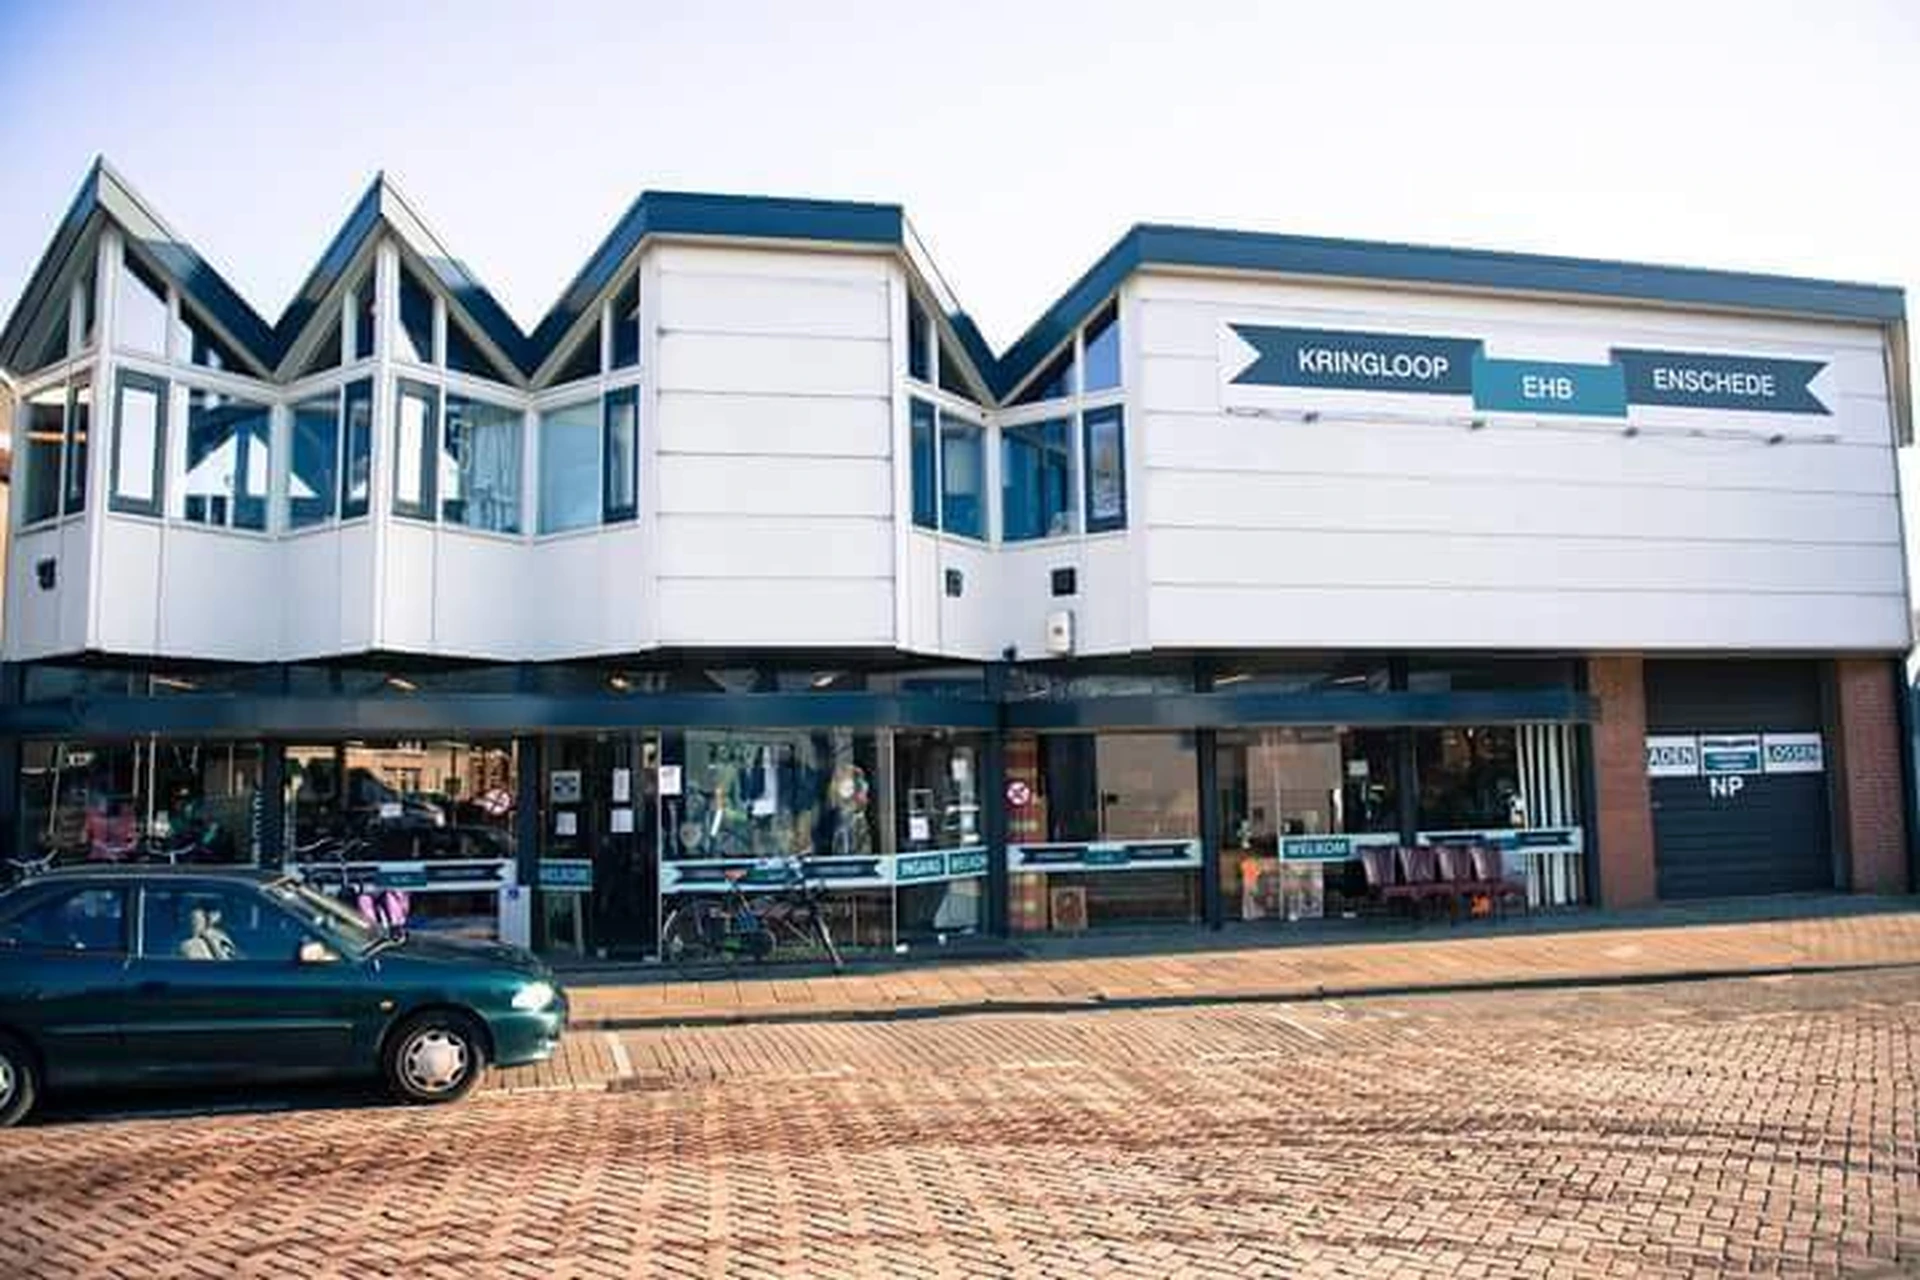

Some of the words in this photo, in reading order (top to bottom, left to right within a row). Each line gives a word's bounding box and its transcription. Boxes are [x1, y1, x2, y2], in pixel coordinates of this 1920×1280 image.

[1298, 348, 1449, 380] KRINGLOOP
[1522, 375, 1574, 401] EHB
[1652, 367, 1777, 398] ENSCHEDE
[1708, 775, 1745, 799] NP
[1286, 841, 1348, 855] WELKOM
